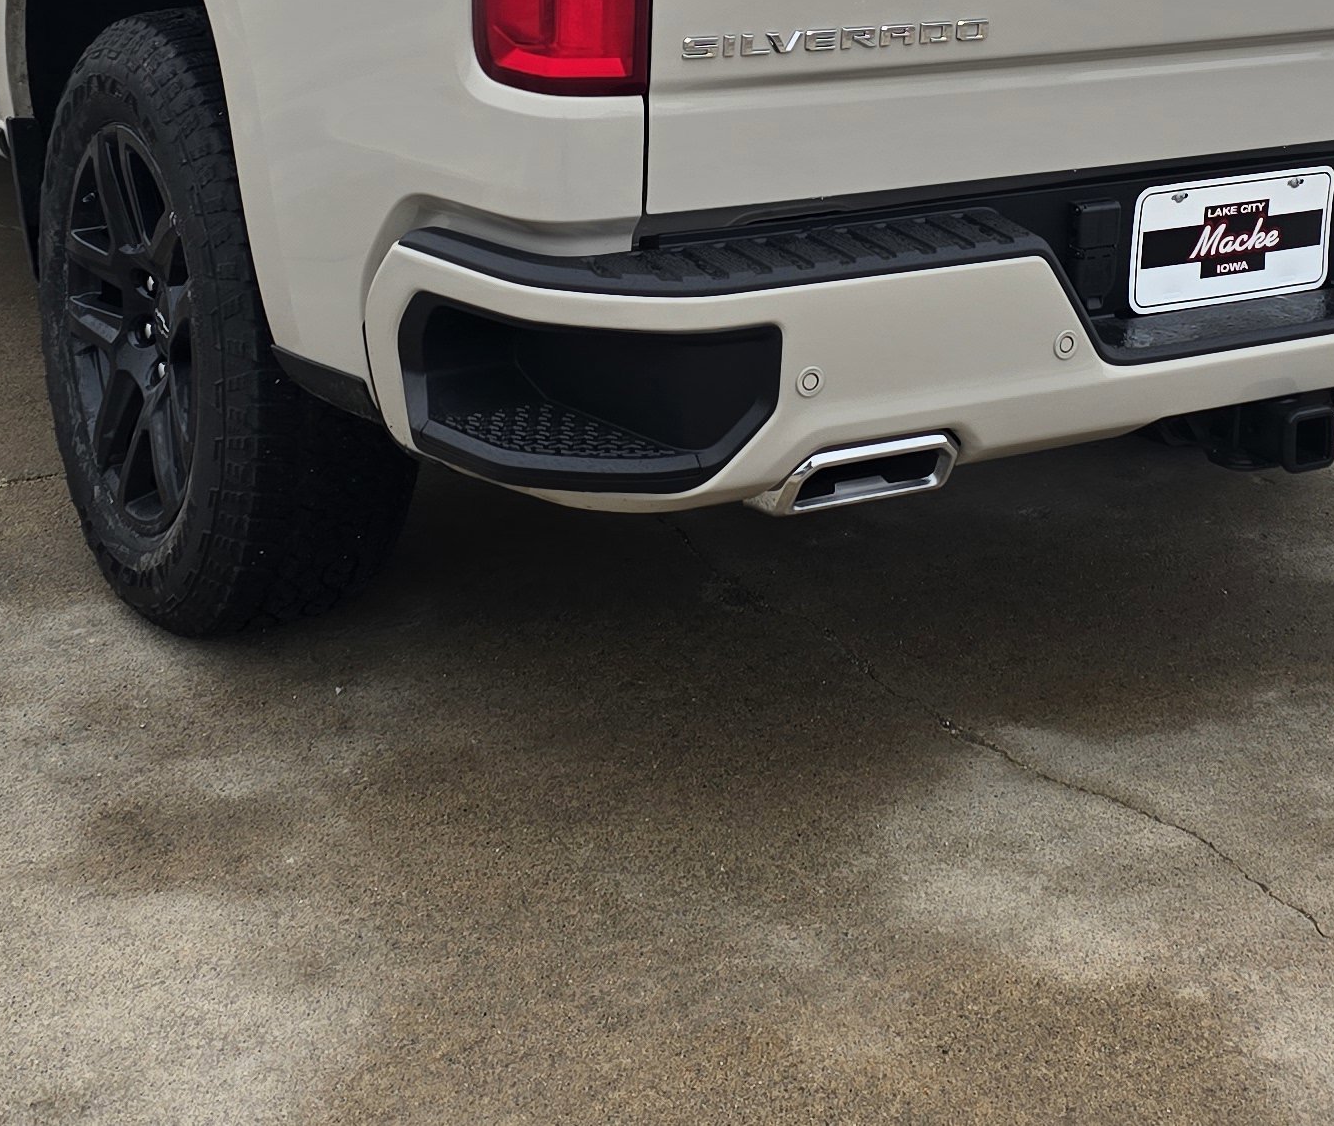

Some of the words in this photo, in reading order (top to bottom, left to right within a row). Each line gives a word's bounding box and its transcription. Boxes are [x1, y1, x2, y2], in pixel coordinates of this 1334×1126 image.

[681, 17, 990, 59] SILVERADO
[1207, 205, 1238, 218] LAKE
[1240, 202, 1265, 214] CITY
[1188, 217, 1280, 259] Macke
[1216, 260, 1249, 273] IOWA
